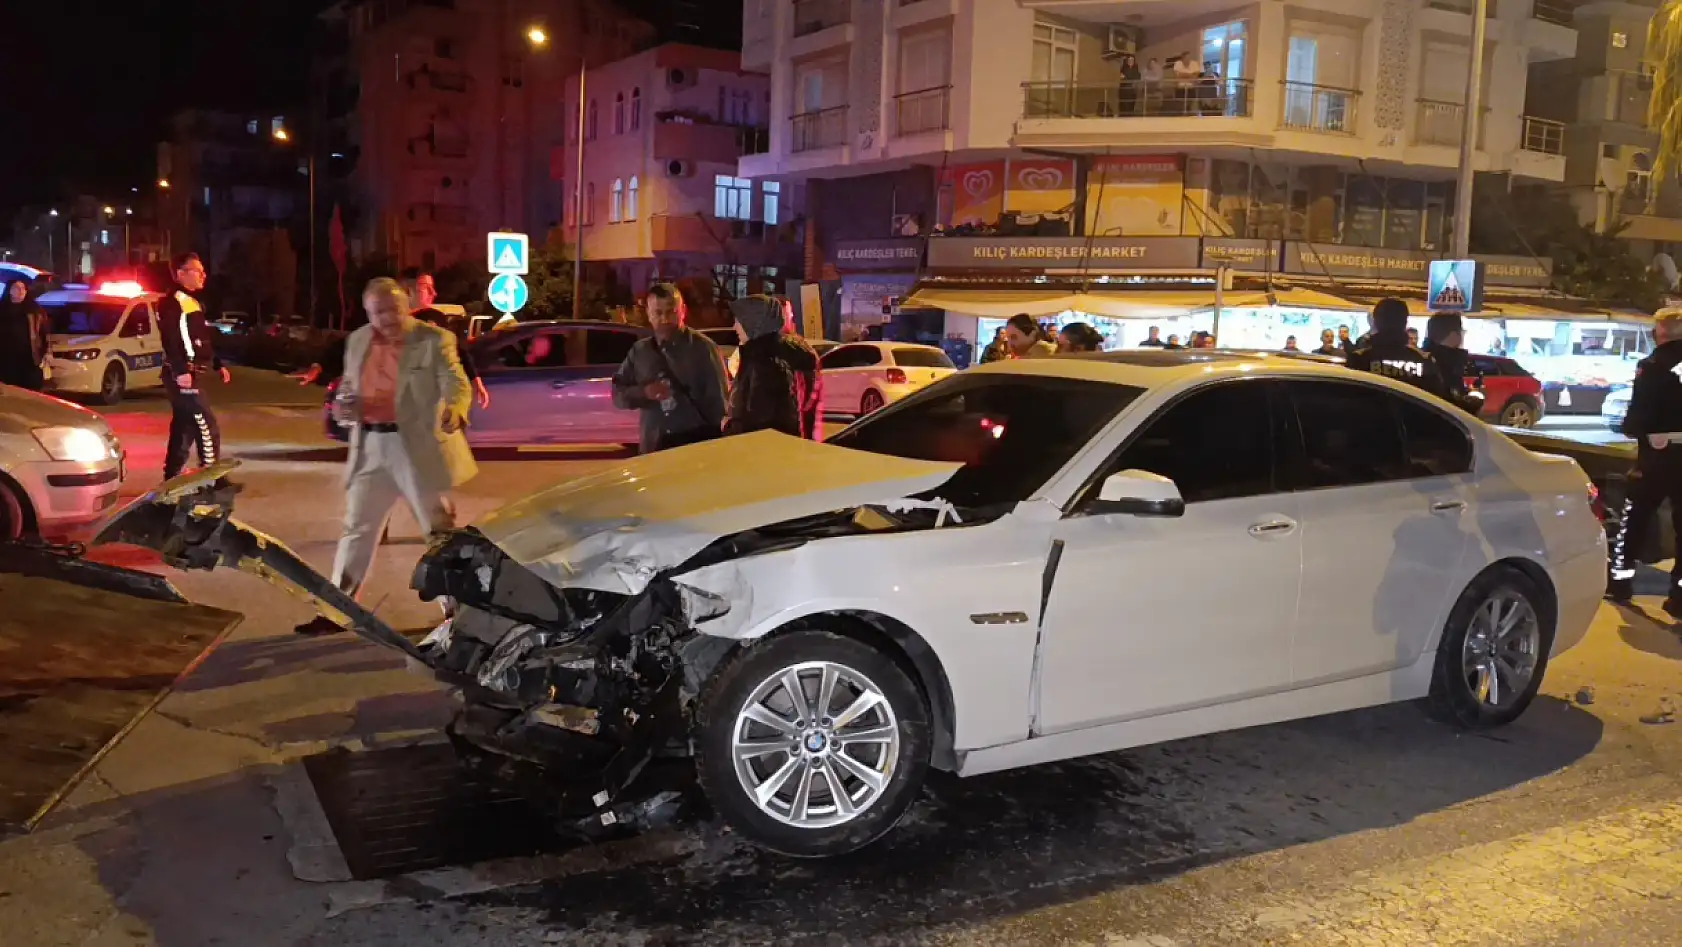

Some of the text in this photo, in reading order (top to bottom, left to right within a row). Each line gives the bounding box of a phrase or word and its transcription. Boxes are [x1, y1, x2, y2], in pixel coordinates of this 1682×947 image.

[973, 246, 1147, 260] KILIÇ KARDEŞLER MARKET
[1205, 246, 1226, 256] KILIÇ
[1300, 251, 1426, 270] KILIÇ KARDEŞLER MARKET
